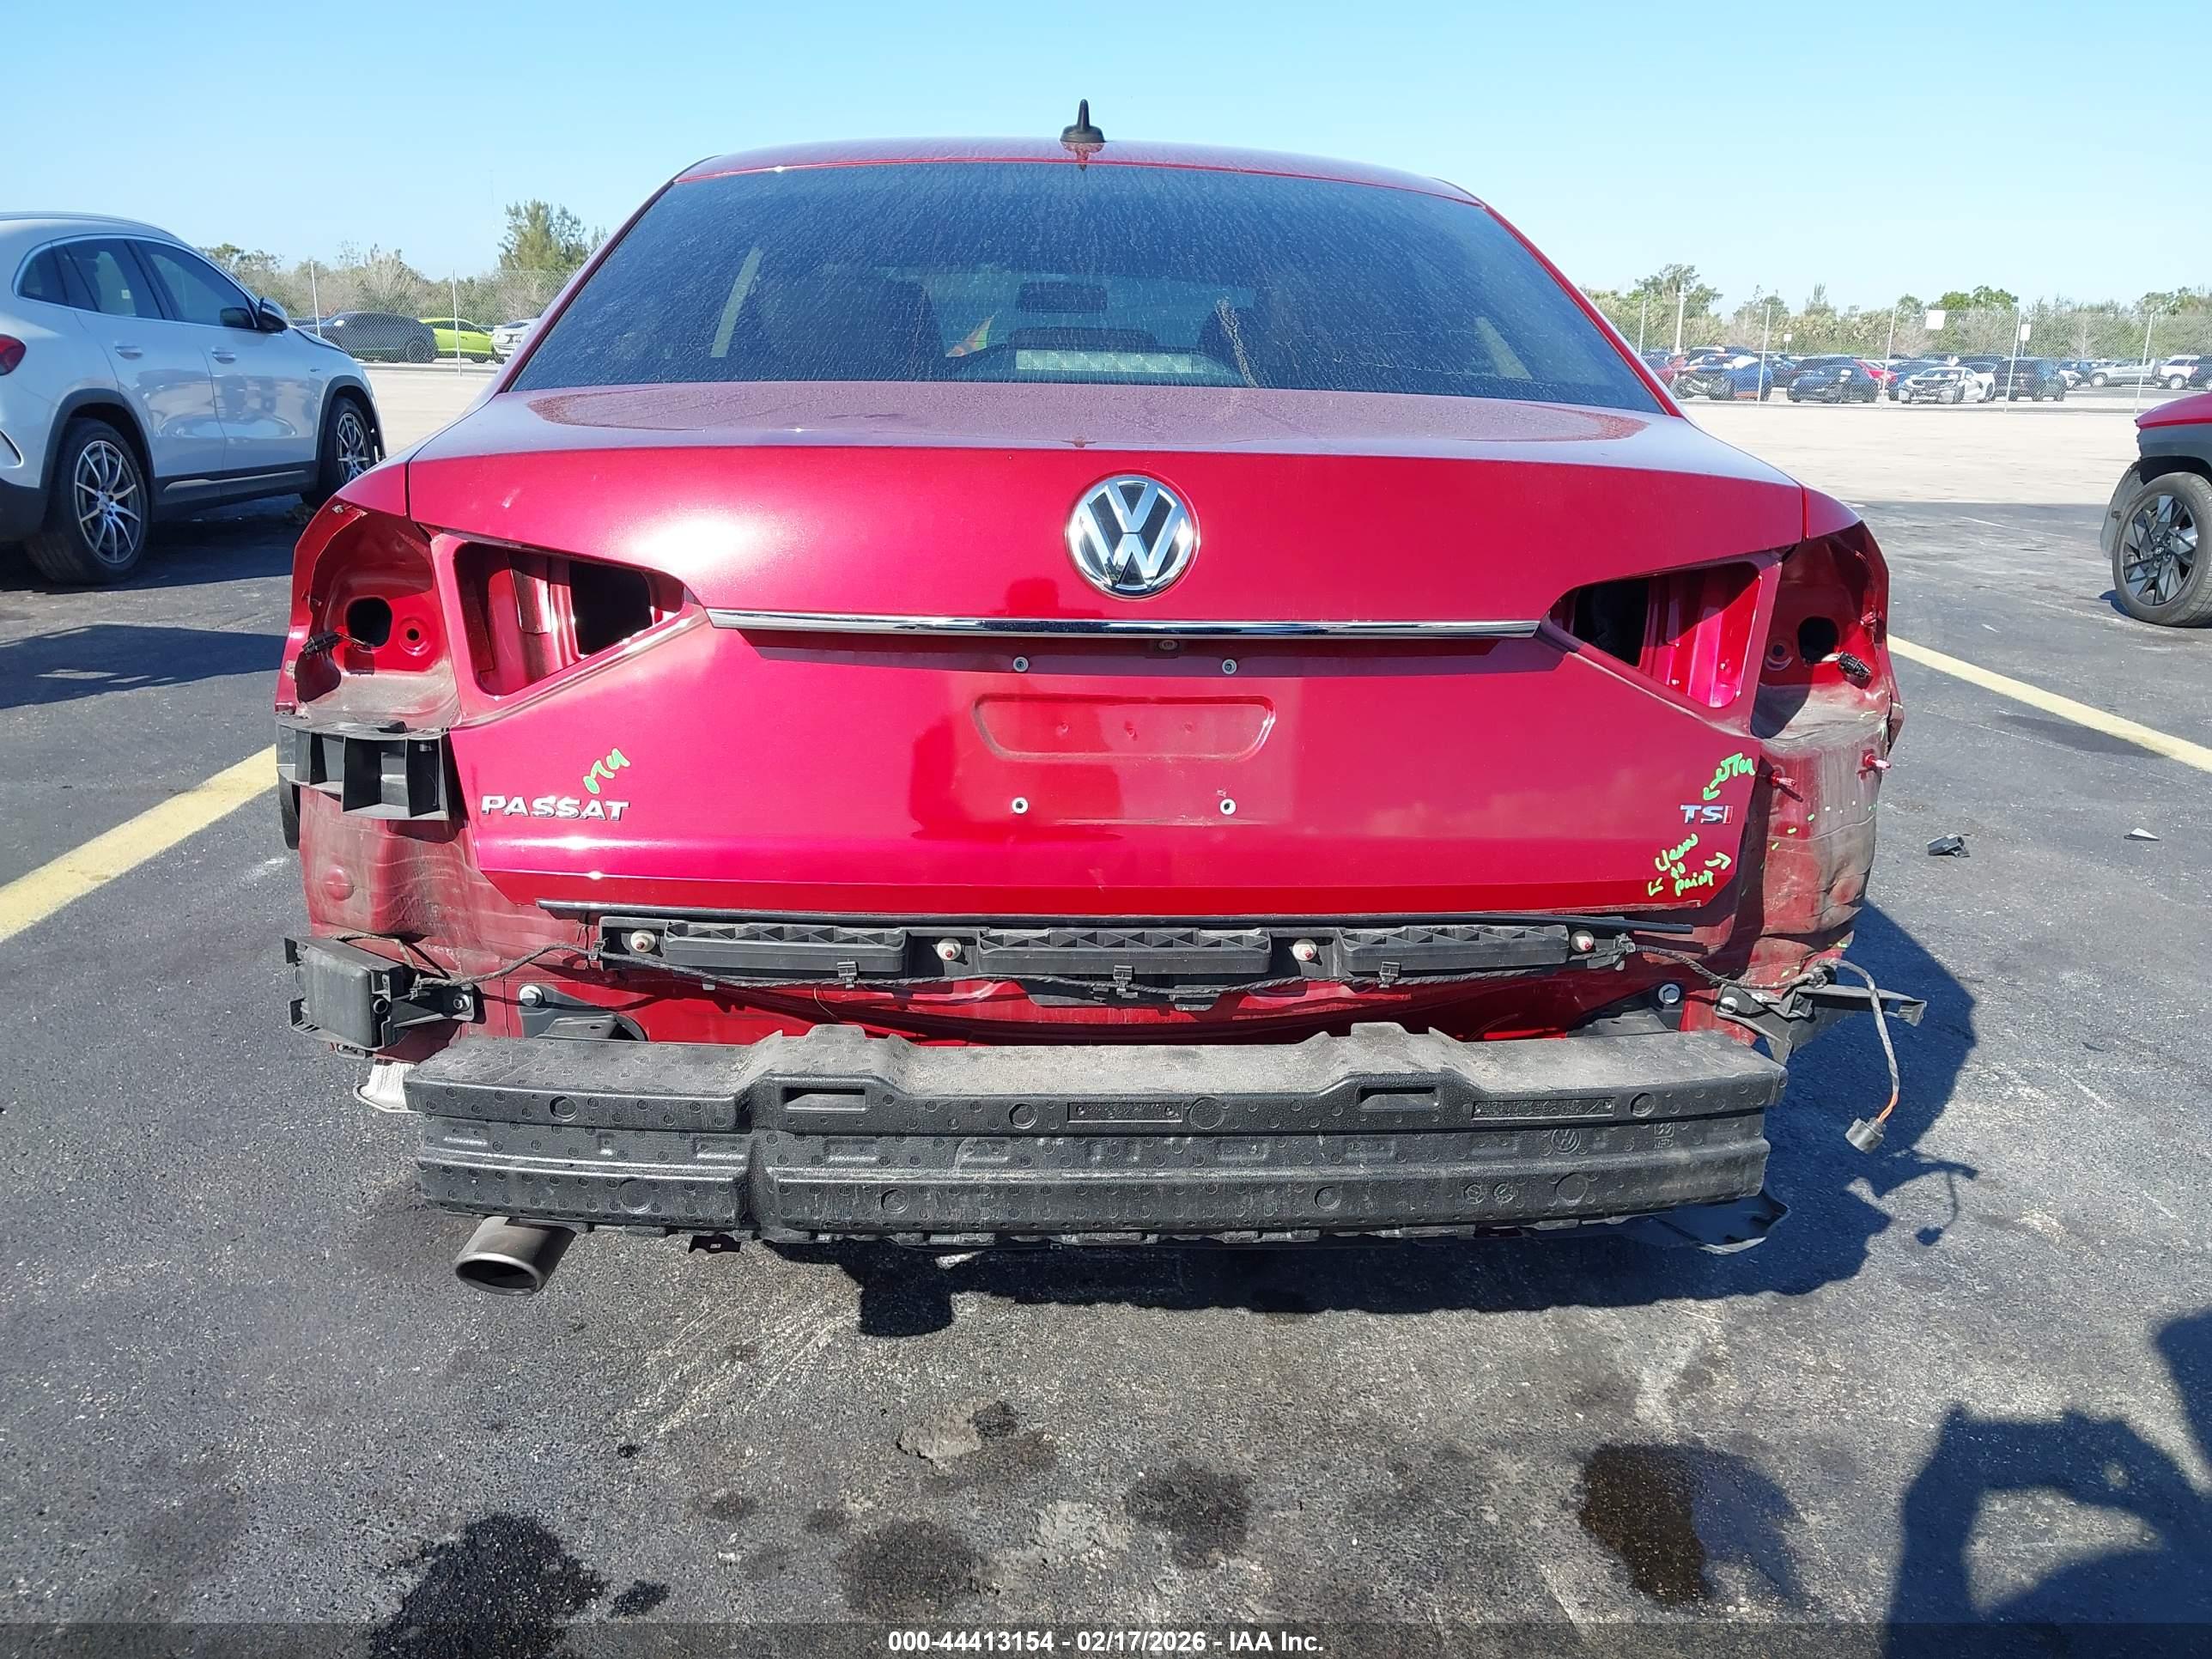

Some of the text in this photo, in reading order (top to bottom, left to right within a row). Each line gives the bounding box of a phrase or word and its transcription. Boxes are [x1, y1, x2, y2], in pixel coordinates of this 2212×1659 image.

[1068, 474, 1194, 599] VW
[481, 794, 631, 822] PASSAT
[1680, 804, 1734, 824] TSI
